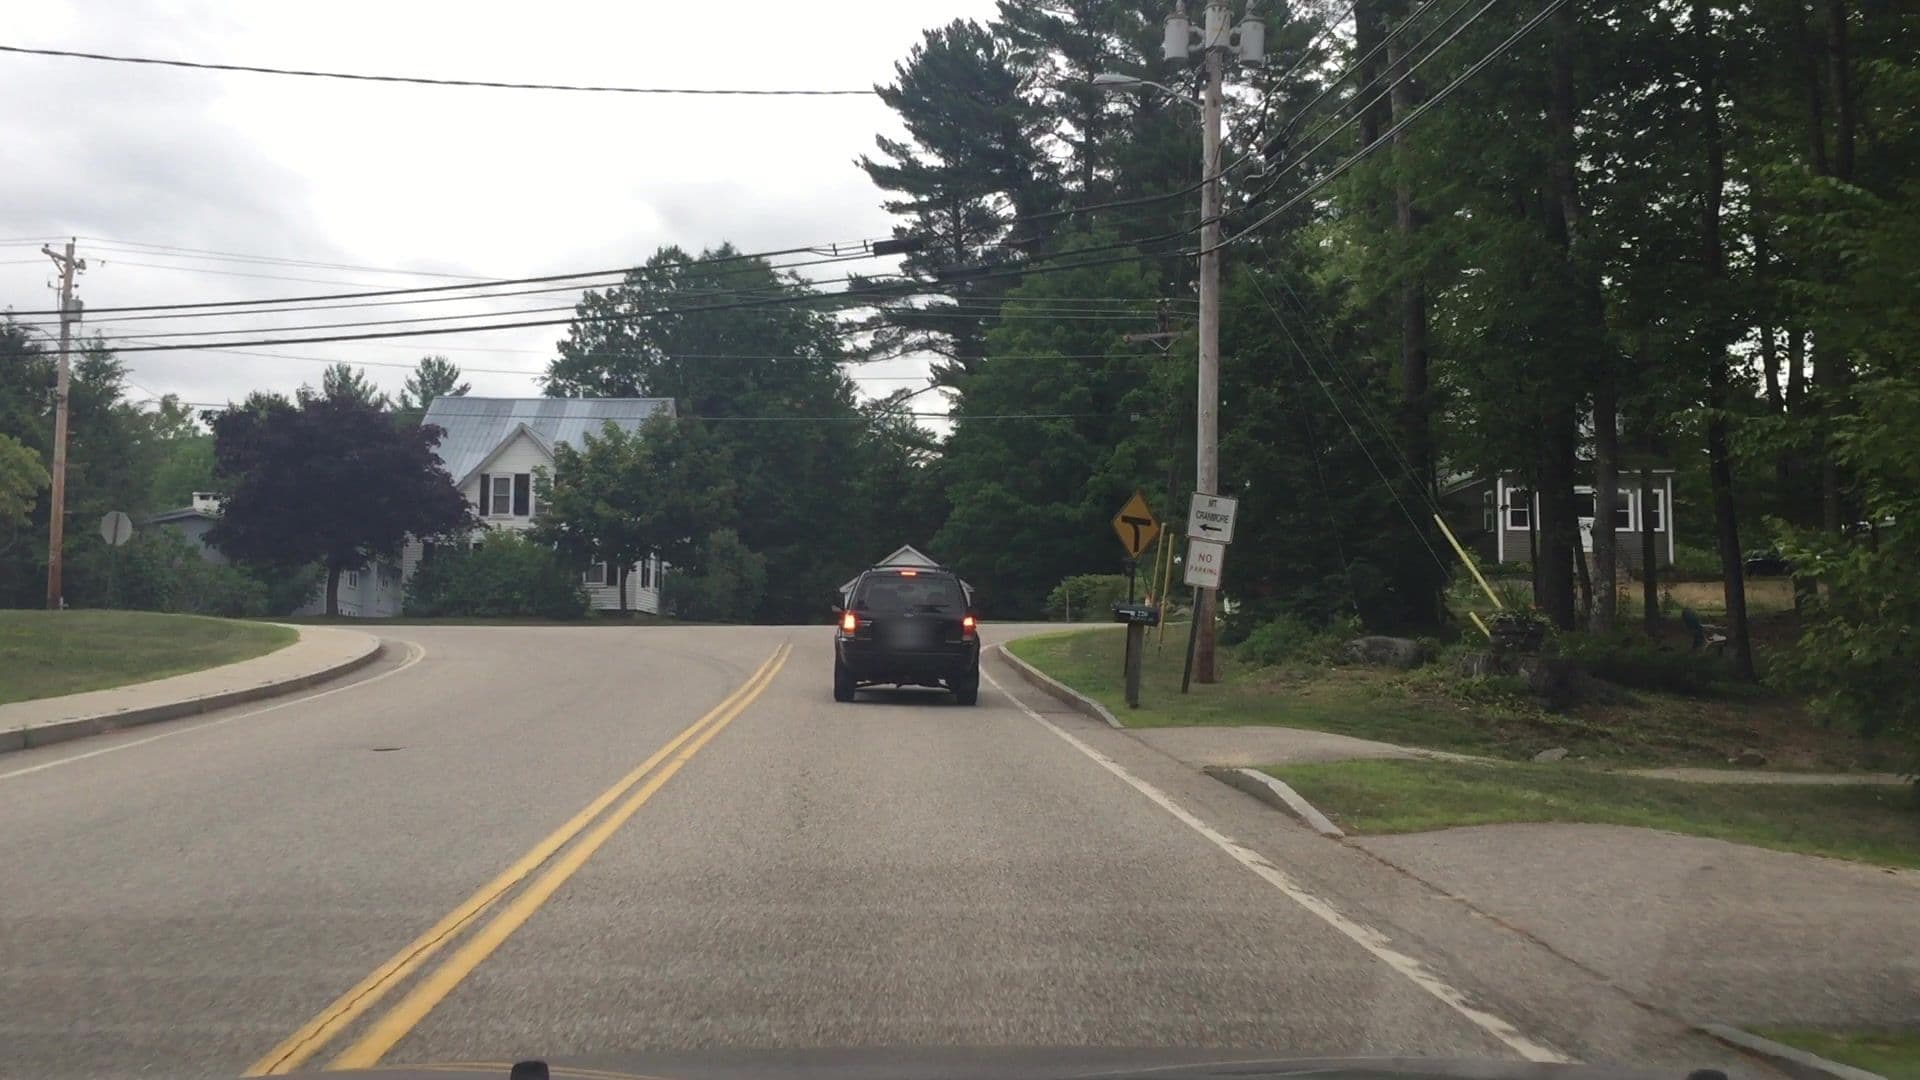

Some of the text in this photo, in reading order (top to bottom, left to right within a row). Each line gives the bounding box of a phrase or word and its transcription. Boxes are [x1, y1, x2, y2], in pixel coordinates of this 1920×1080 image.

[1195, 510, 1229, 524] CRANMORE
[1198, 552, 1212, 564] NO
[1189, 565, 1217, 576] PARKING
